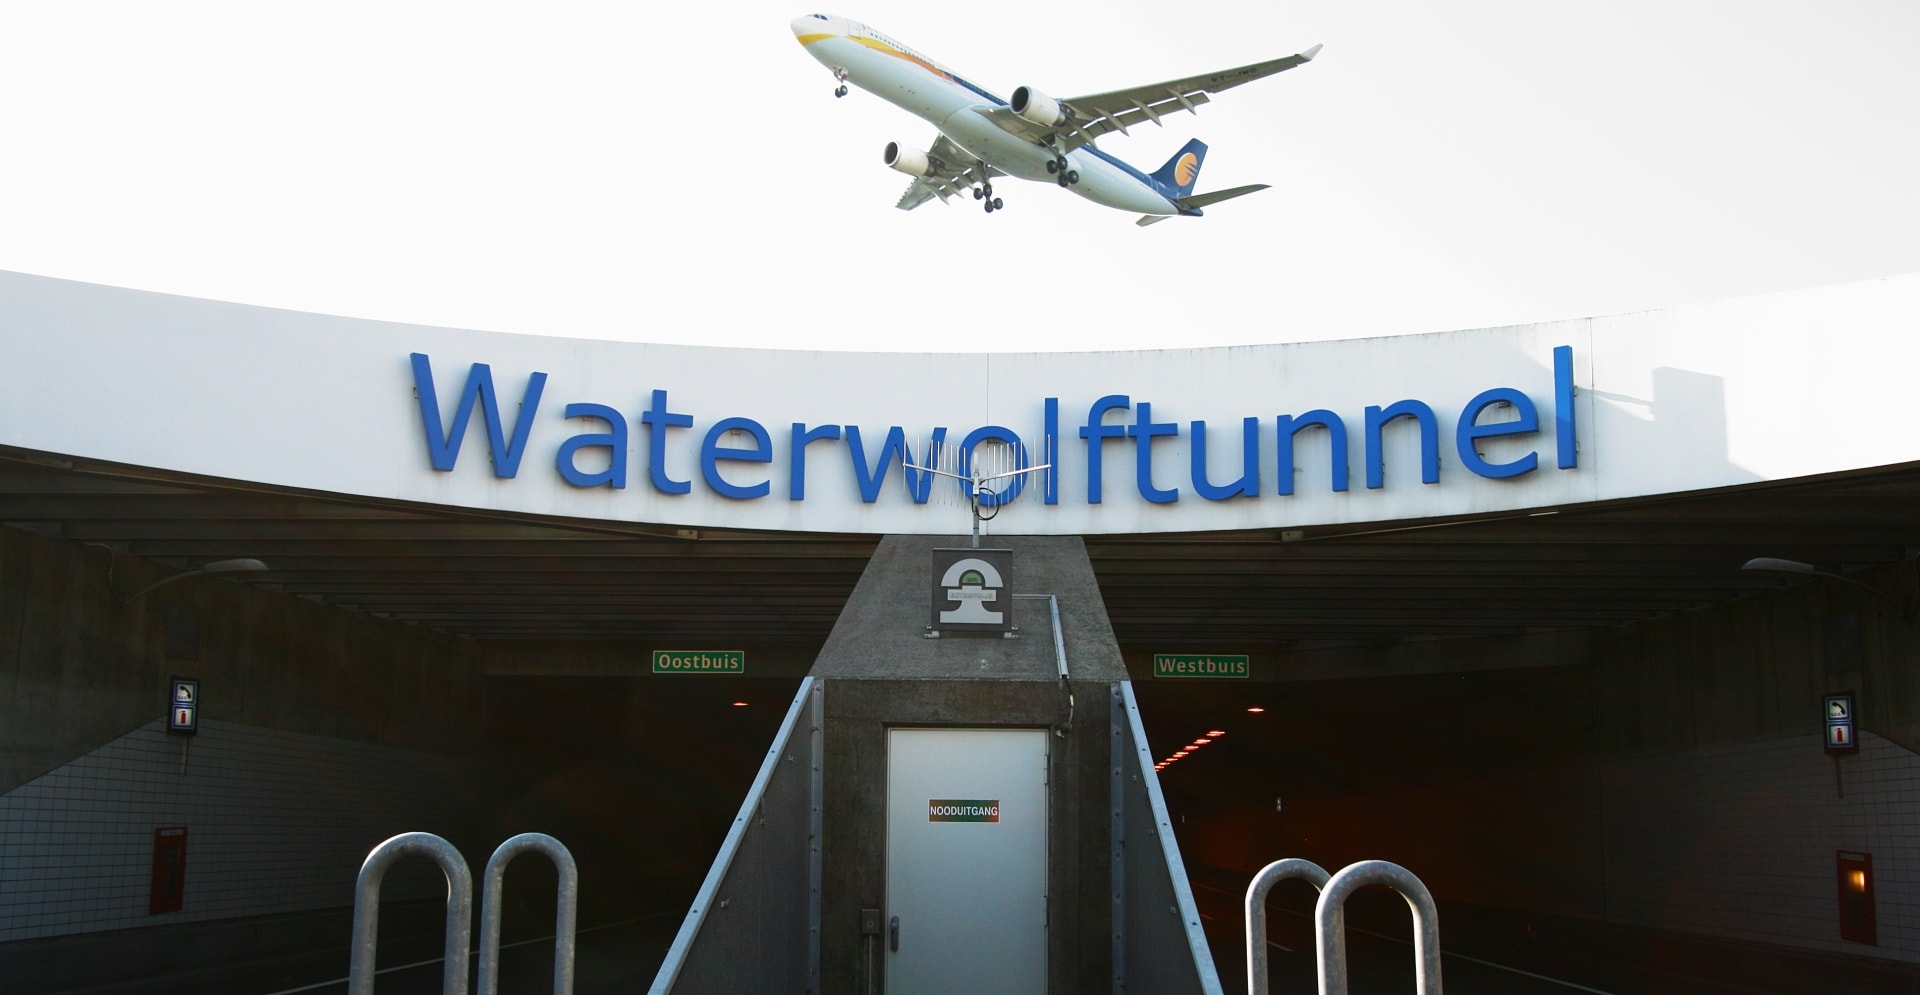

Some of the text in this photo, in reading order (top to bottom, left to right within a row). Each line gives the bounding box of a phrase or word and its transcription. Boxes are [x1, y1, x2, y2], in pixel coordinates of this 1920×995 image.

[410, 345, 1578, 506] Waterwolftunnel
[658, 653, 738, 669] Oostbuis
[1159, 657, 1245, 673] Westbuis
[930, 805, 998, 816] NOODUITGANG
